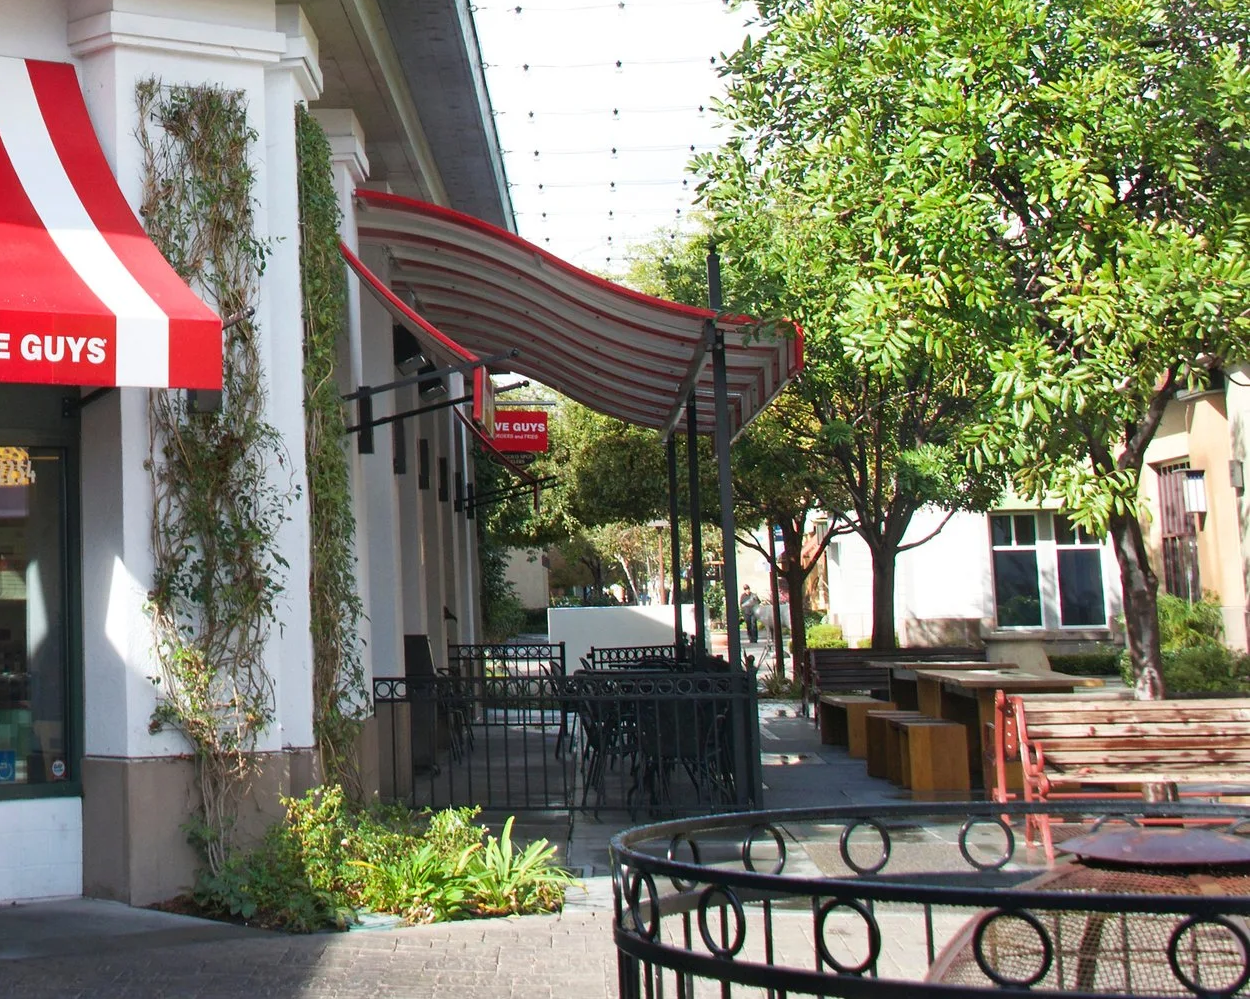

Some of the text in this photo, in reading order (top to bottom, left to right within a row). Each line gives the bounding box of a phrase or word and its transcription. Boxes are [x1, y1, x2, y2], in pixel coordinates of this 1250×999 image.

[20, 333, 106, 364] GUYS
[494, 422, 545, 432] VE GUYS
